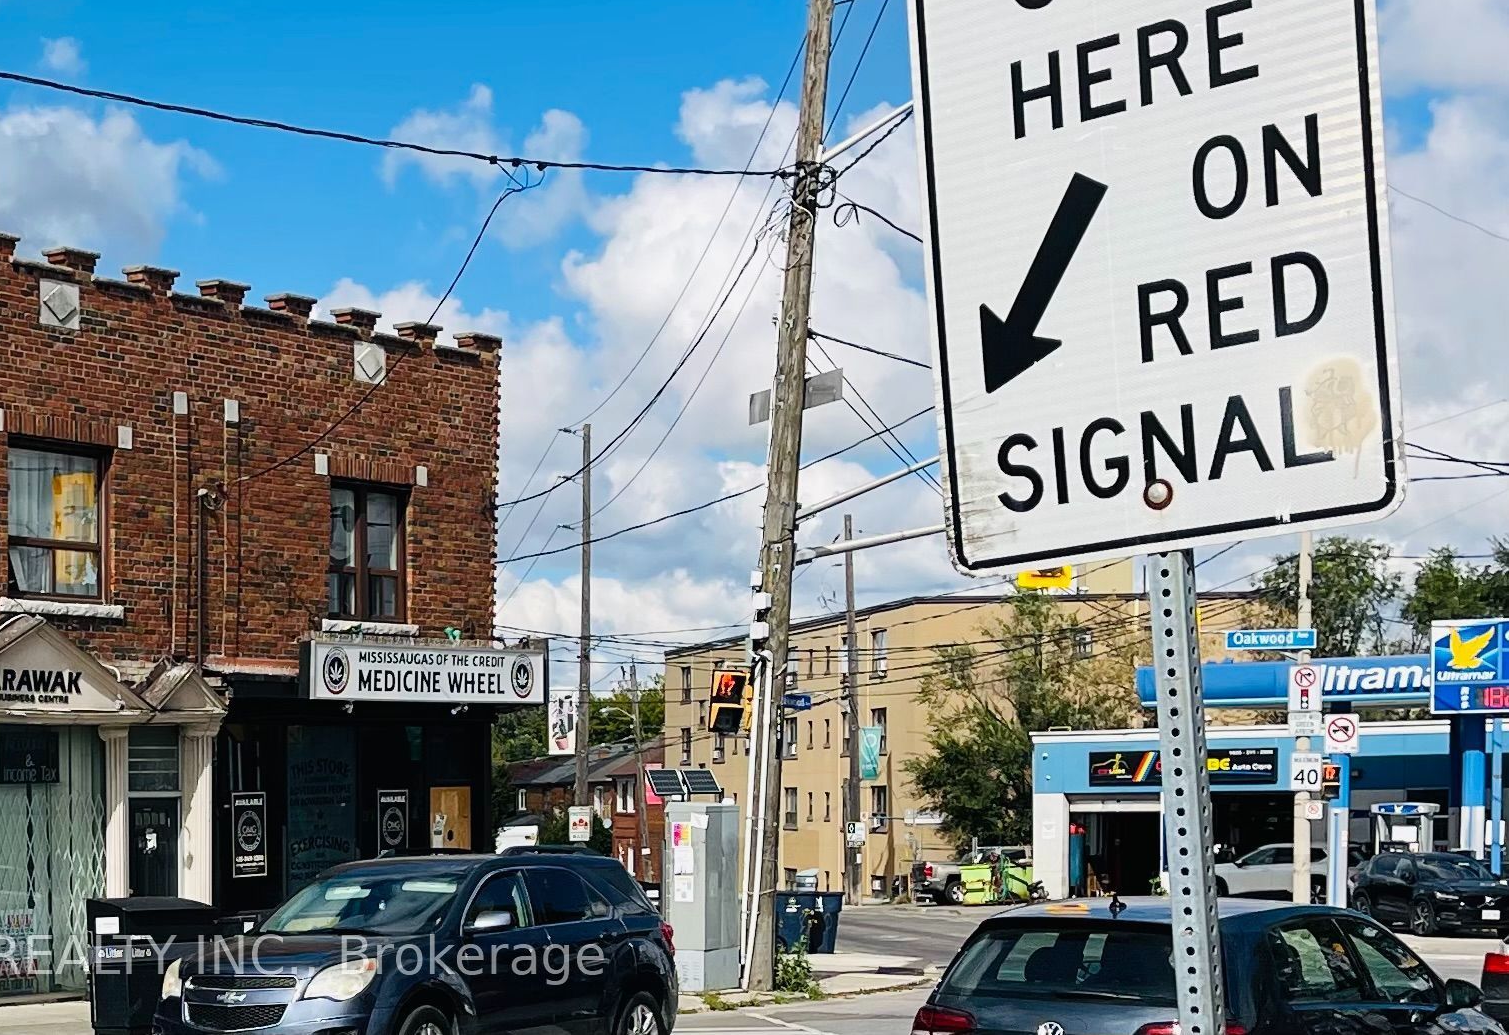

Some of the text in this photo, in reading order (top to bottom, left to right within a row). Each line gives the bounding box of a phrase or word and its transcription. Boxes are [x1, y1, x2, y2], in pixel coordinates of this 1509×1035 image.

[1192, 113, 1323, 220] ON
[1137, 251, 1329, 363] RED
[996, 386, 1335, 513] SIGNAL
[1233, 631, 1294, 645] Oakwood
[359, 651, 506, 668] MISSISSAUGAS OF THE CREDIT
[358, 669, 441, 693] MEDICINE
[447, 670, 506, 695] WHEEL
[1322, 664, 1430, 692] ltram
[1436, 670, 1496, 681] Ultramar
[38, 694, 69, 704] CENTRE
[41, 765, 57, 781] Tax
[1231, 763, 1251, 771] Auto
[1252, 762, 1272, 771] Care
[1293, 768, 1319, 785] 40
[105, 947, 123, 958] Litter
